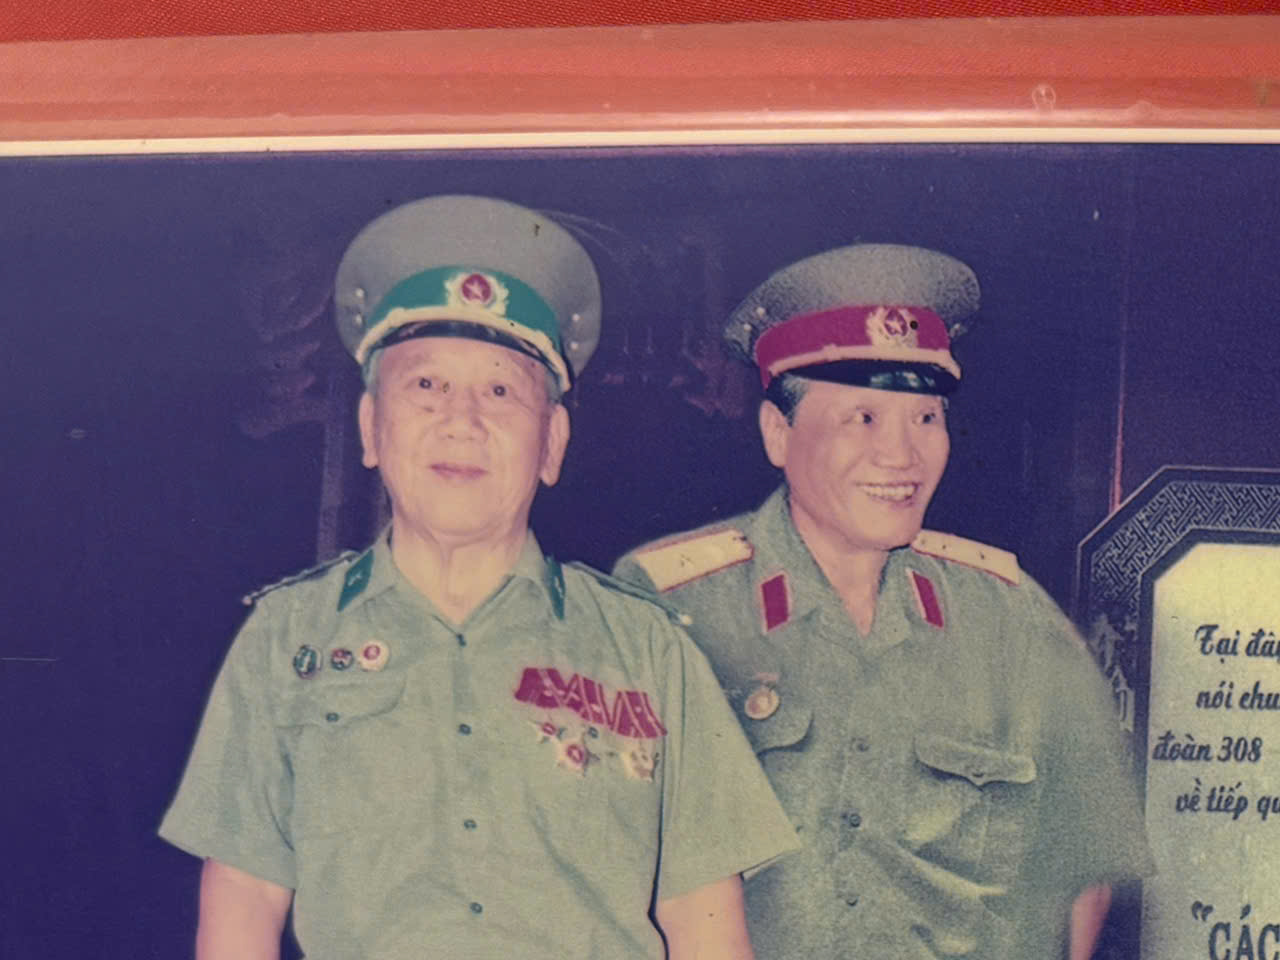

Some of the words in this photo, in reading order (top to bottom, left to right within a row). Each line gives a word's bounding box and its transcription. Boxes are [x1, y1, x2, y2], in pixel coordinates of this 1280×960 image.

[1194, 624, 1240, 664] Tại
[1195, 680, 1234, 709] nói
[1151, 730, 1213, 762] đoàn
[1217, 736, 1264, 763] 308
[1175, 778, 1202, 812] về
[1206, 781, 1249, 821] tiếp
